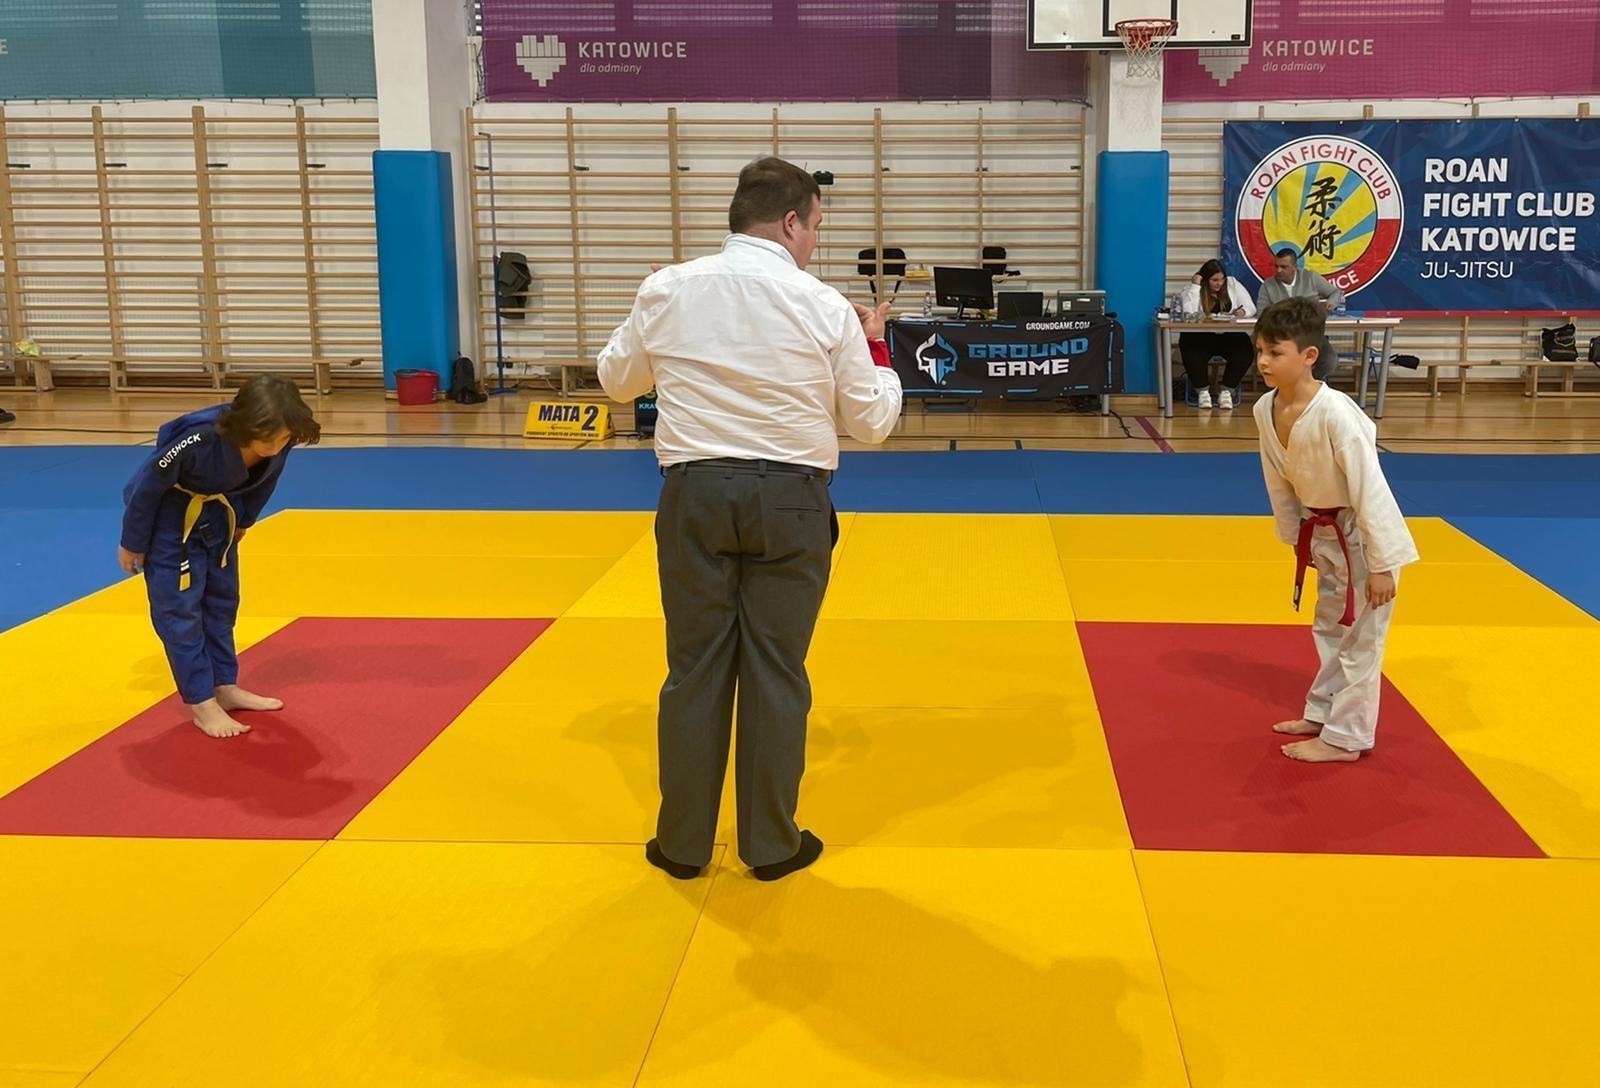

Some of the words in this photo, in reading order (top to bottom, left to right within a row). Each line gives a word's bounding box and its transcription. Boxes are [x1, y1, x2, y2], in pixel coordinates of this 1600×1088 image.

[578, 41, 687, 58] KATOWICE
[1262, 39, 1374, 57] KATOWICE
[580, 63, 595, 73] dla
[598, 63, 642, 74] odmiany
[1262, 62, 1278, 72] dla
[1281, 61, 1326, 72] odmiany
[1250, 151, 1298, 199] ROAN
[1300, 143, 1357, 164] FIGHT
[1357, 157, 1392, 200] CLUB
[1425, 158, 1508, 183] ROAN
[1423, 193, 1511, 217] FIGHT
[1517, 192, 1595, 217] CLUB
[1421, 227, 1576, 251] KATOWICE
[1420, 261, 1514, 279] JU-JITSU
[1026, 321, 1090, 330] GROUNDGAME.COM
[967, 337, 1089, 359] GROUND
[987, 358, 1069, 377] GAME
[538, 405, 580, 422] MATA
[581, 405, 599, 431] 2
[158, 432, 201, 469] OUTSHOCK
